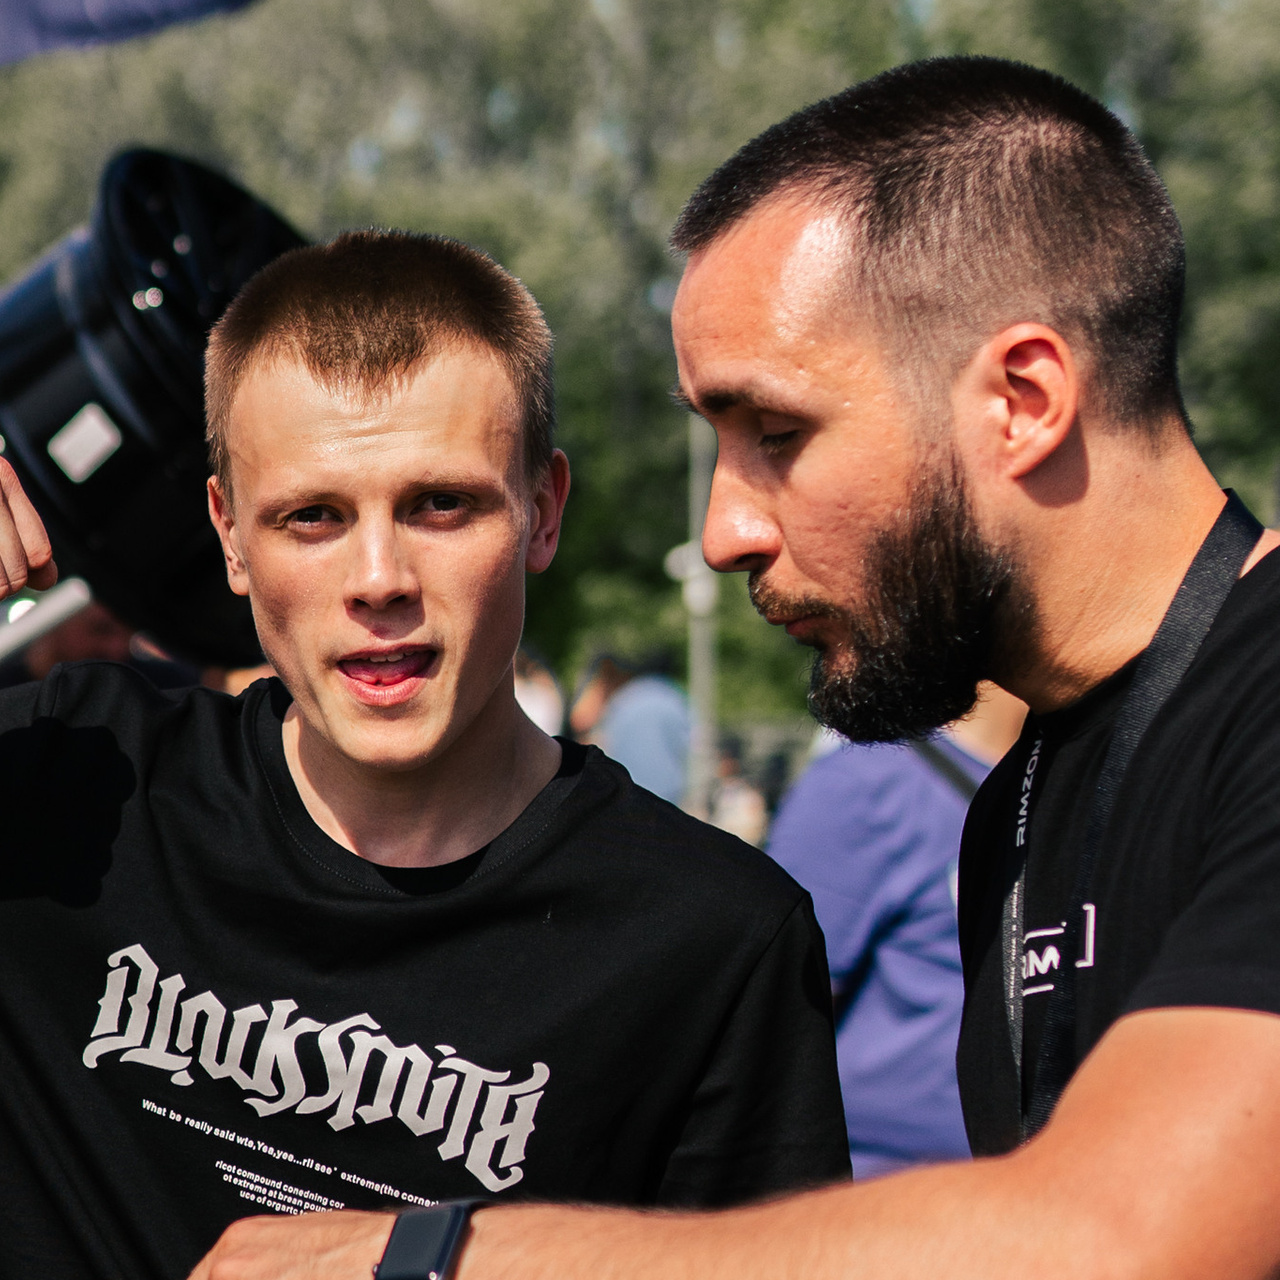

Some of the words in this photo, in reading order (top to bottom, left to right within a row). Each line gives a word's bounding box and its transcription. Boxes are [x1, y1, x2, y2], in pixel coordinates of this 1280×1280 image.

[1016, 730, 1043, 847] RIMZON
[142, 1099, 167, 1117] What
[184, 1117, 213, 1135] really
[232, 1177, 267, 1195] extreme
[236, 1168, 282, 1189] compound
